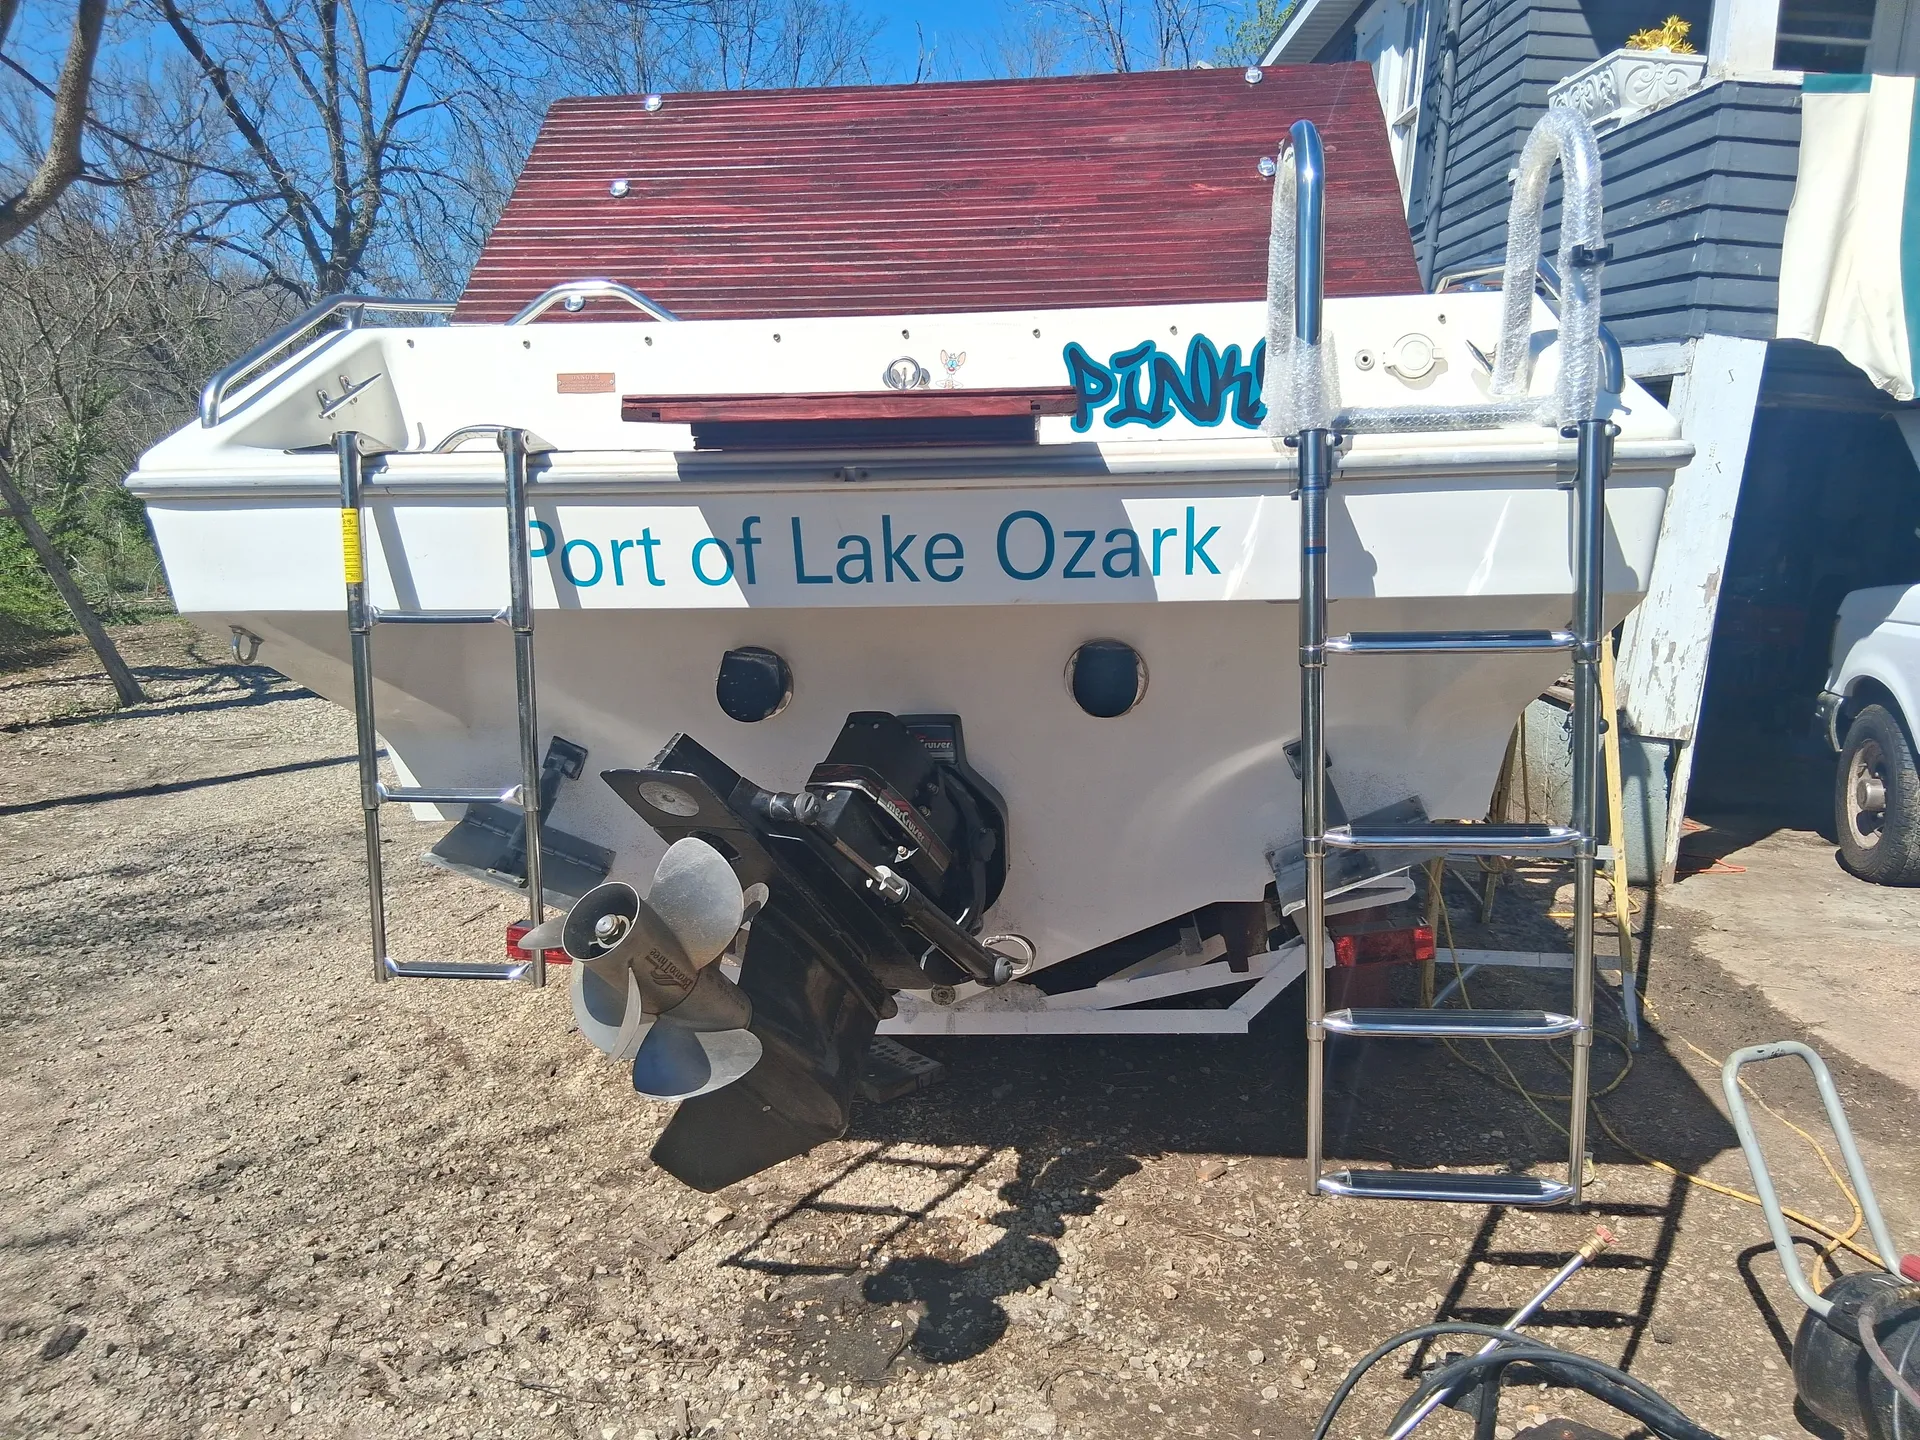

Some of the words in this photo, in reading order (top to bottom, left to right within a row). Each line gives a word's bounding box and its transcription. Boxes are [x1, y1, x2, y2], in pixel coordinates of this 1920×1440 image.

[1063, 333, 1268, 433] PINK
[529, 519, 666, 588] Port
[691, 515, 763, 587] of
[790, 514, 966, 585] Lake
[996, 506, 1223, 581] Ozark
